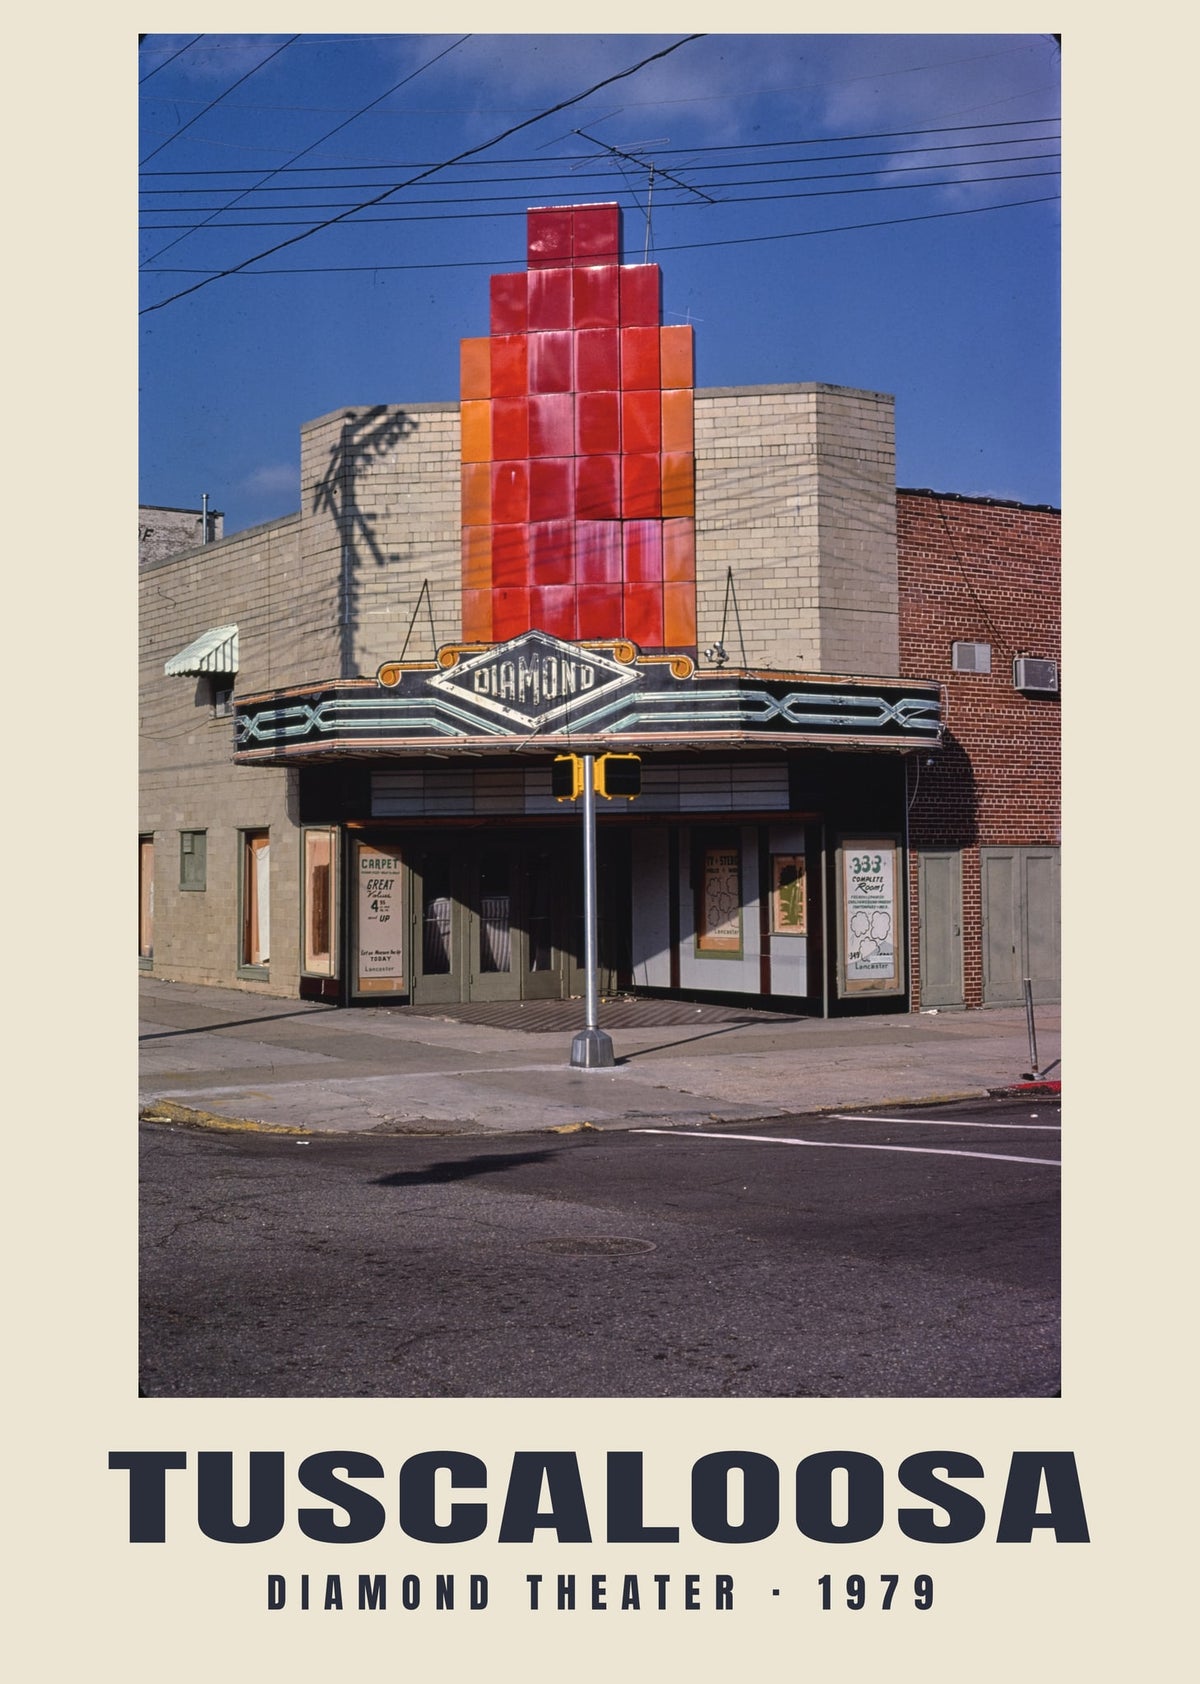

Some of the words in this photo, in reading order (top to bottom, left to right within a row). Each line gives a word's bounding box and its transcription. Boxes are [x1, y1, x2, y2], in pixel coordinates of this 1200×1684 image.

[474, 652, 595, 706] DIAMOND
[361, 858, 399, 870] CARPET
[367, 879, 394, 890] GREAT
[371, 899, 379, 912] 4
[855, 962, 889, 970] Lancaster
